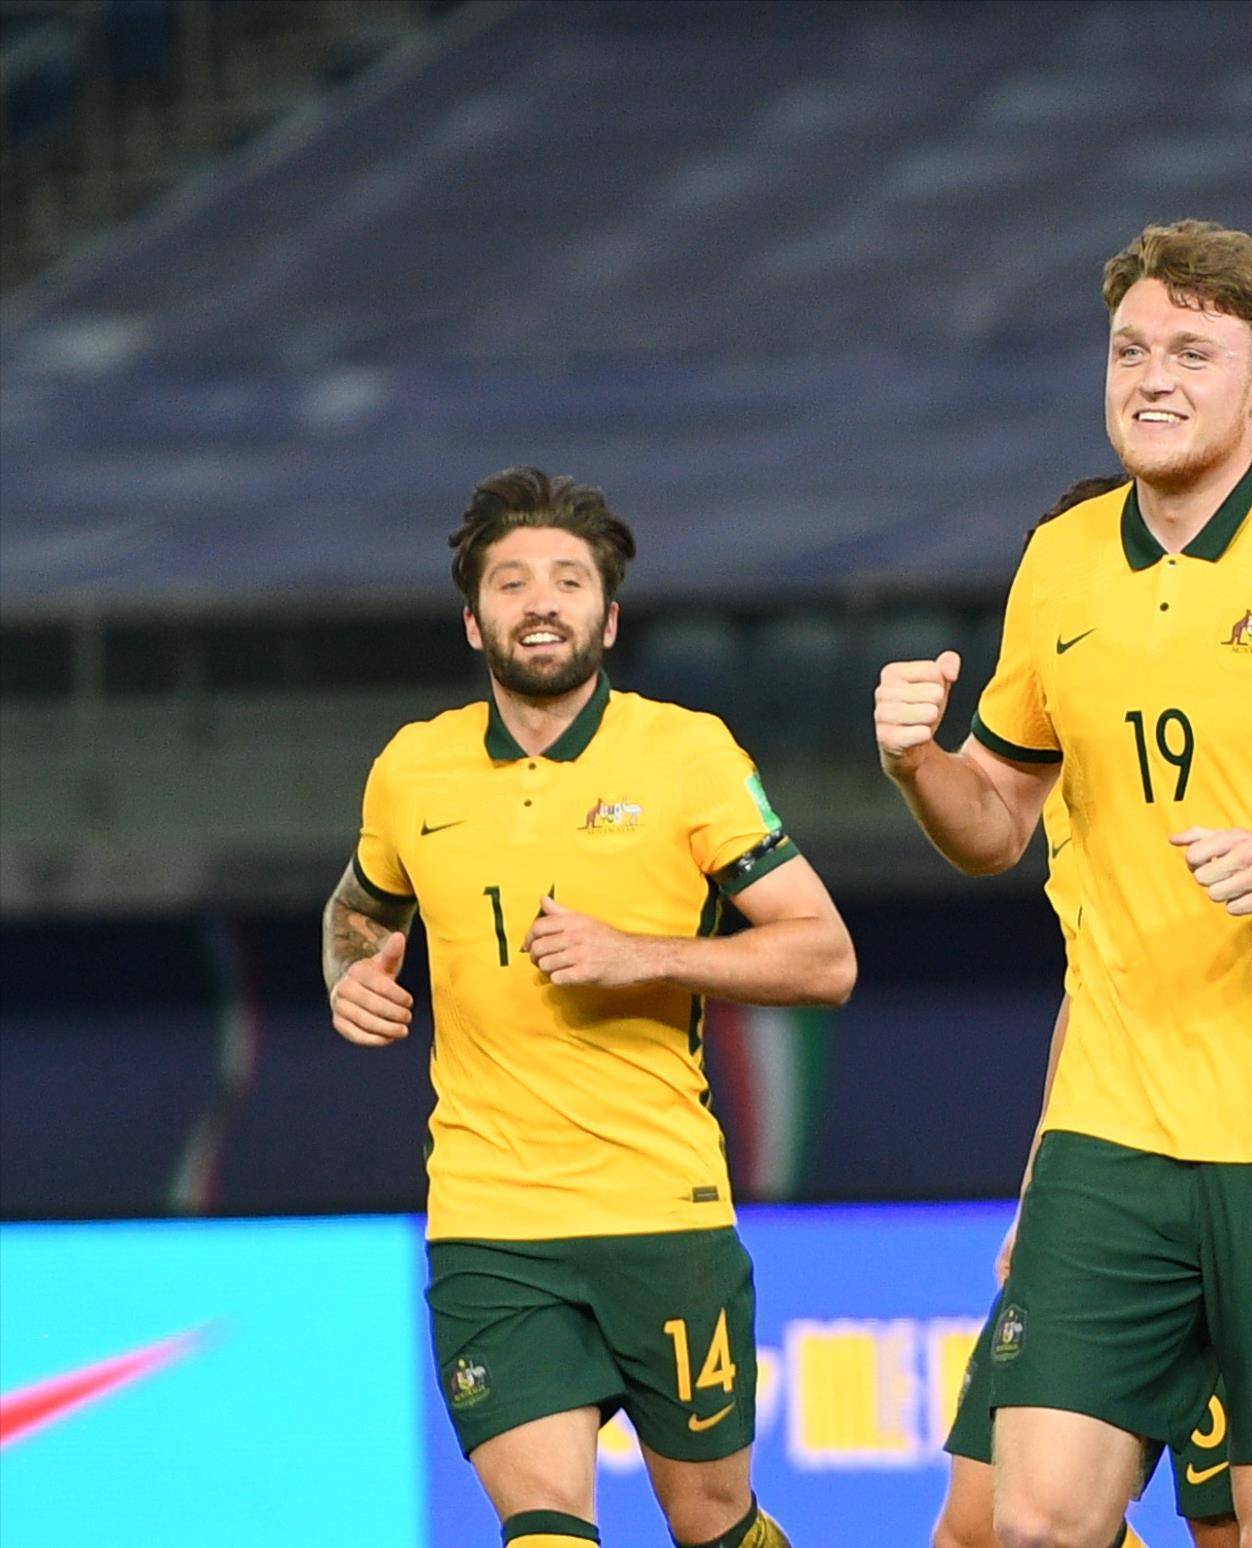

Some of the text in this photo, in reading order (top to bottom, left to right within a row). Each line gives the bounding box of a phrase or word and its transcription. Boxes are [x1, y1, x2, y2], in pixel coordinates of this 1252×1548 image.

[1125, 708, 1194, 804] 19
[483, 883, 556, 967] 1
[664, 1307, 736, 1401] 14
